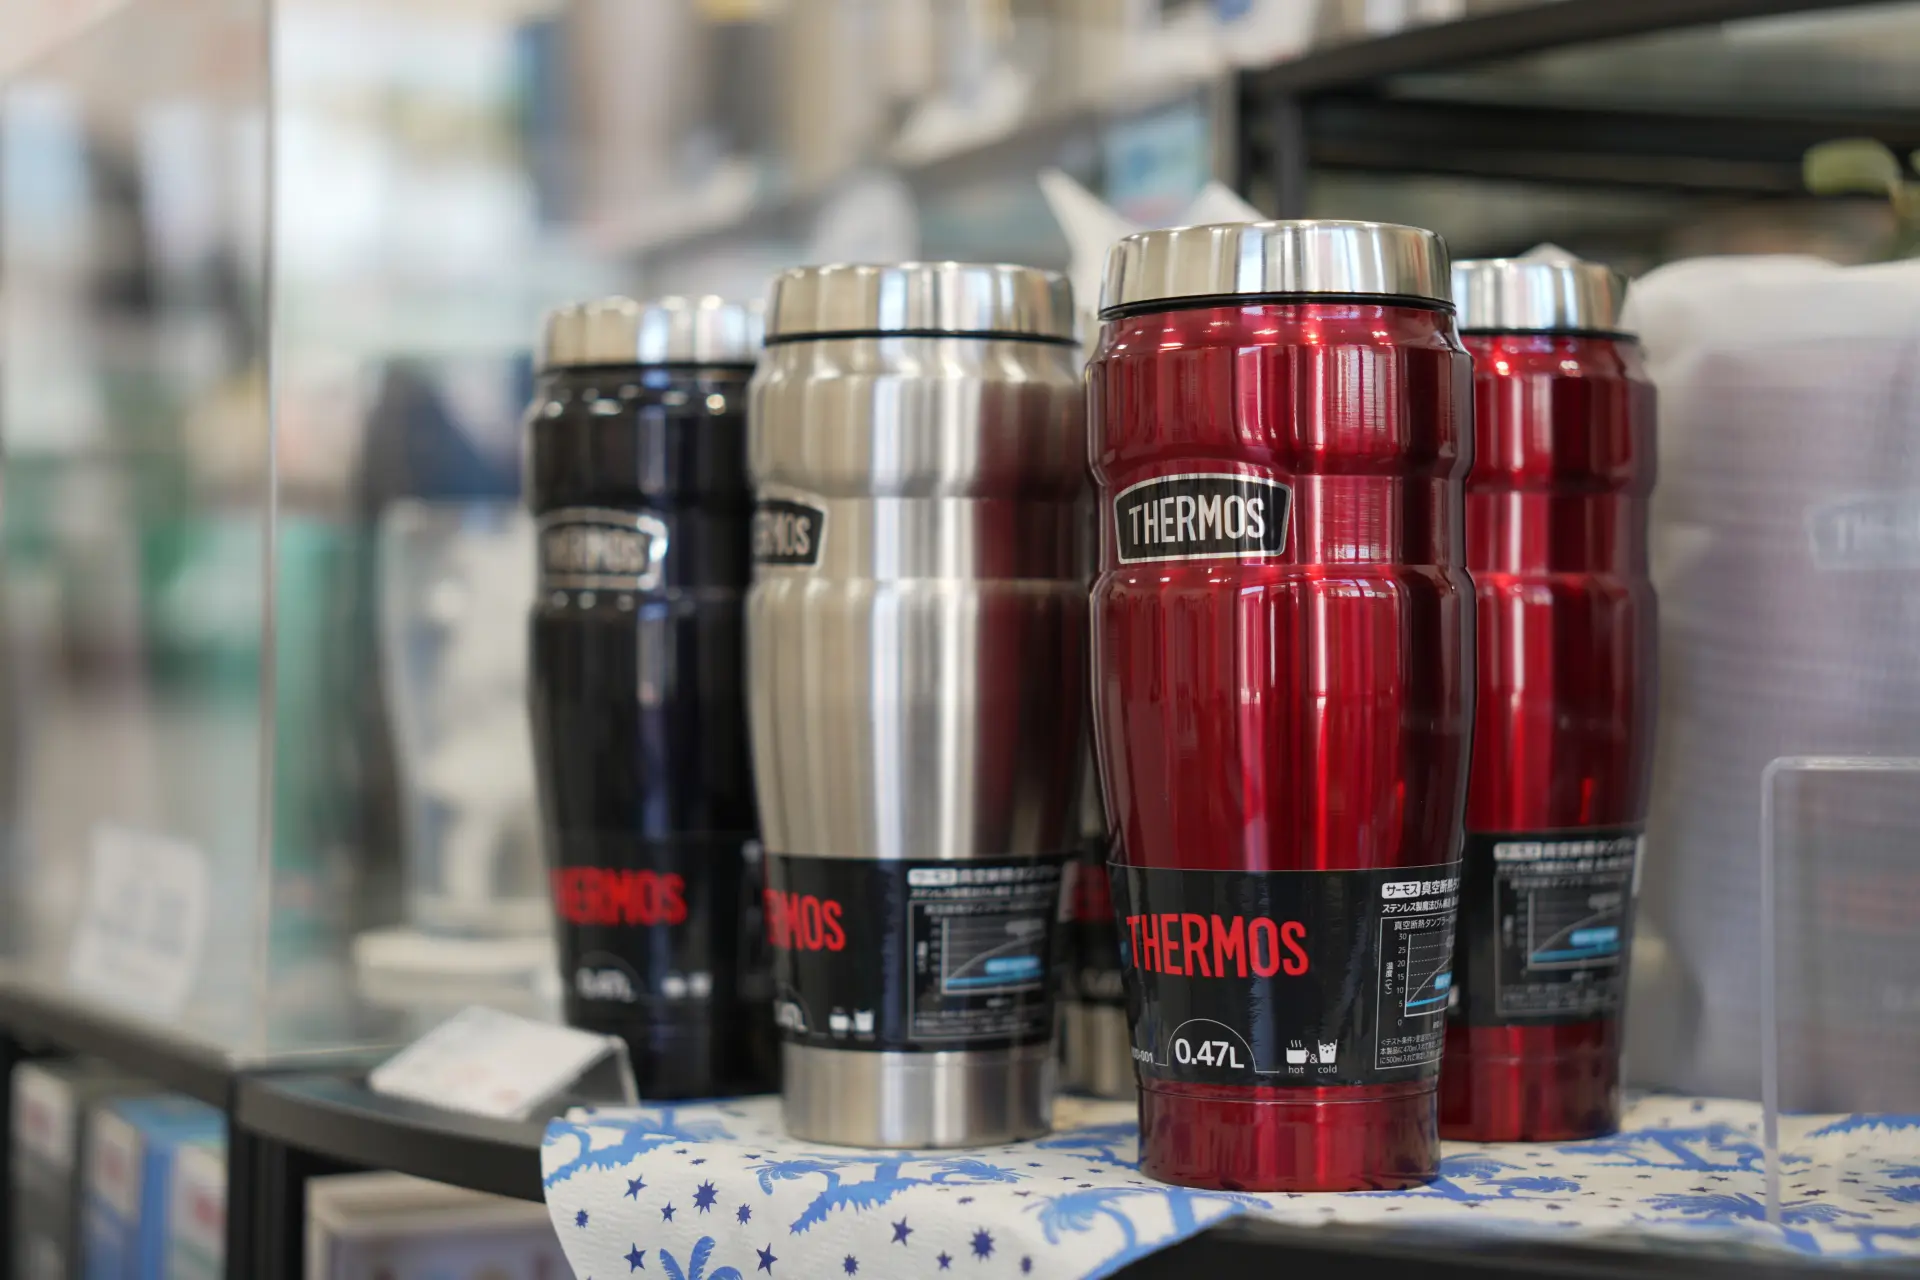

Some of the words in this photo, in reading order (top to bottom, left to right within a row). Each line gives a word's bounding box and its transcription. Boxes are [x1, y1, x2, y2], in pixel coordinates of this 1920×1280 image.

[1129, 494, 1265, 545] THERMOS
[1386, 883, 1418, 897] サーモス
[1126, 913, 1309, 978] THERMOS
[1175, 1038, 1245, 1069] 0.47L
[1309, 1055, 1318, 1064] &
[1288, 1065, 1304, 1074] hot
[1318, 1065, 1338, 1074] cold
